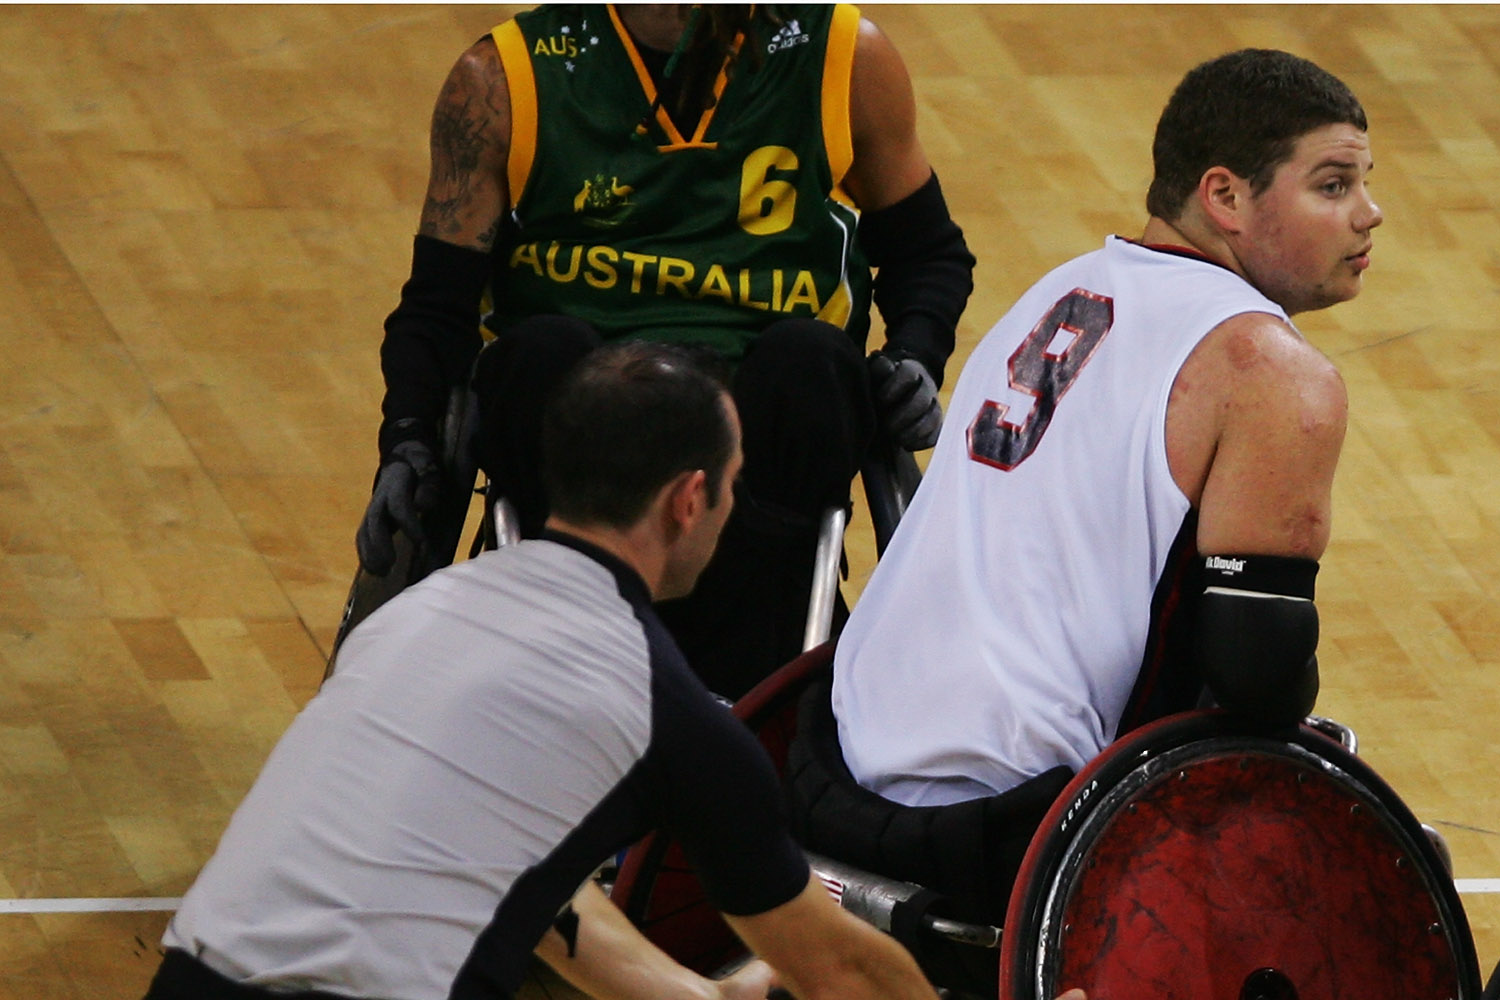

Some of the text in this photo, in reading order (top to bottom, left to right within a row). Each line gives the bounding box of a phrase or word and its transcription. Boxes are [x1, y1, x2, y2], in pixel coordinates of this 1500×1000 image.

[534, 35, 577, 57] AUS
[737, 145, 799, 236] 6
[509, 240, 821, 314] AUSTRALIA
[966, 287, 1114, 472] 9
[1061, 780, 1099, 831] KENDA
